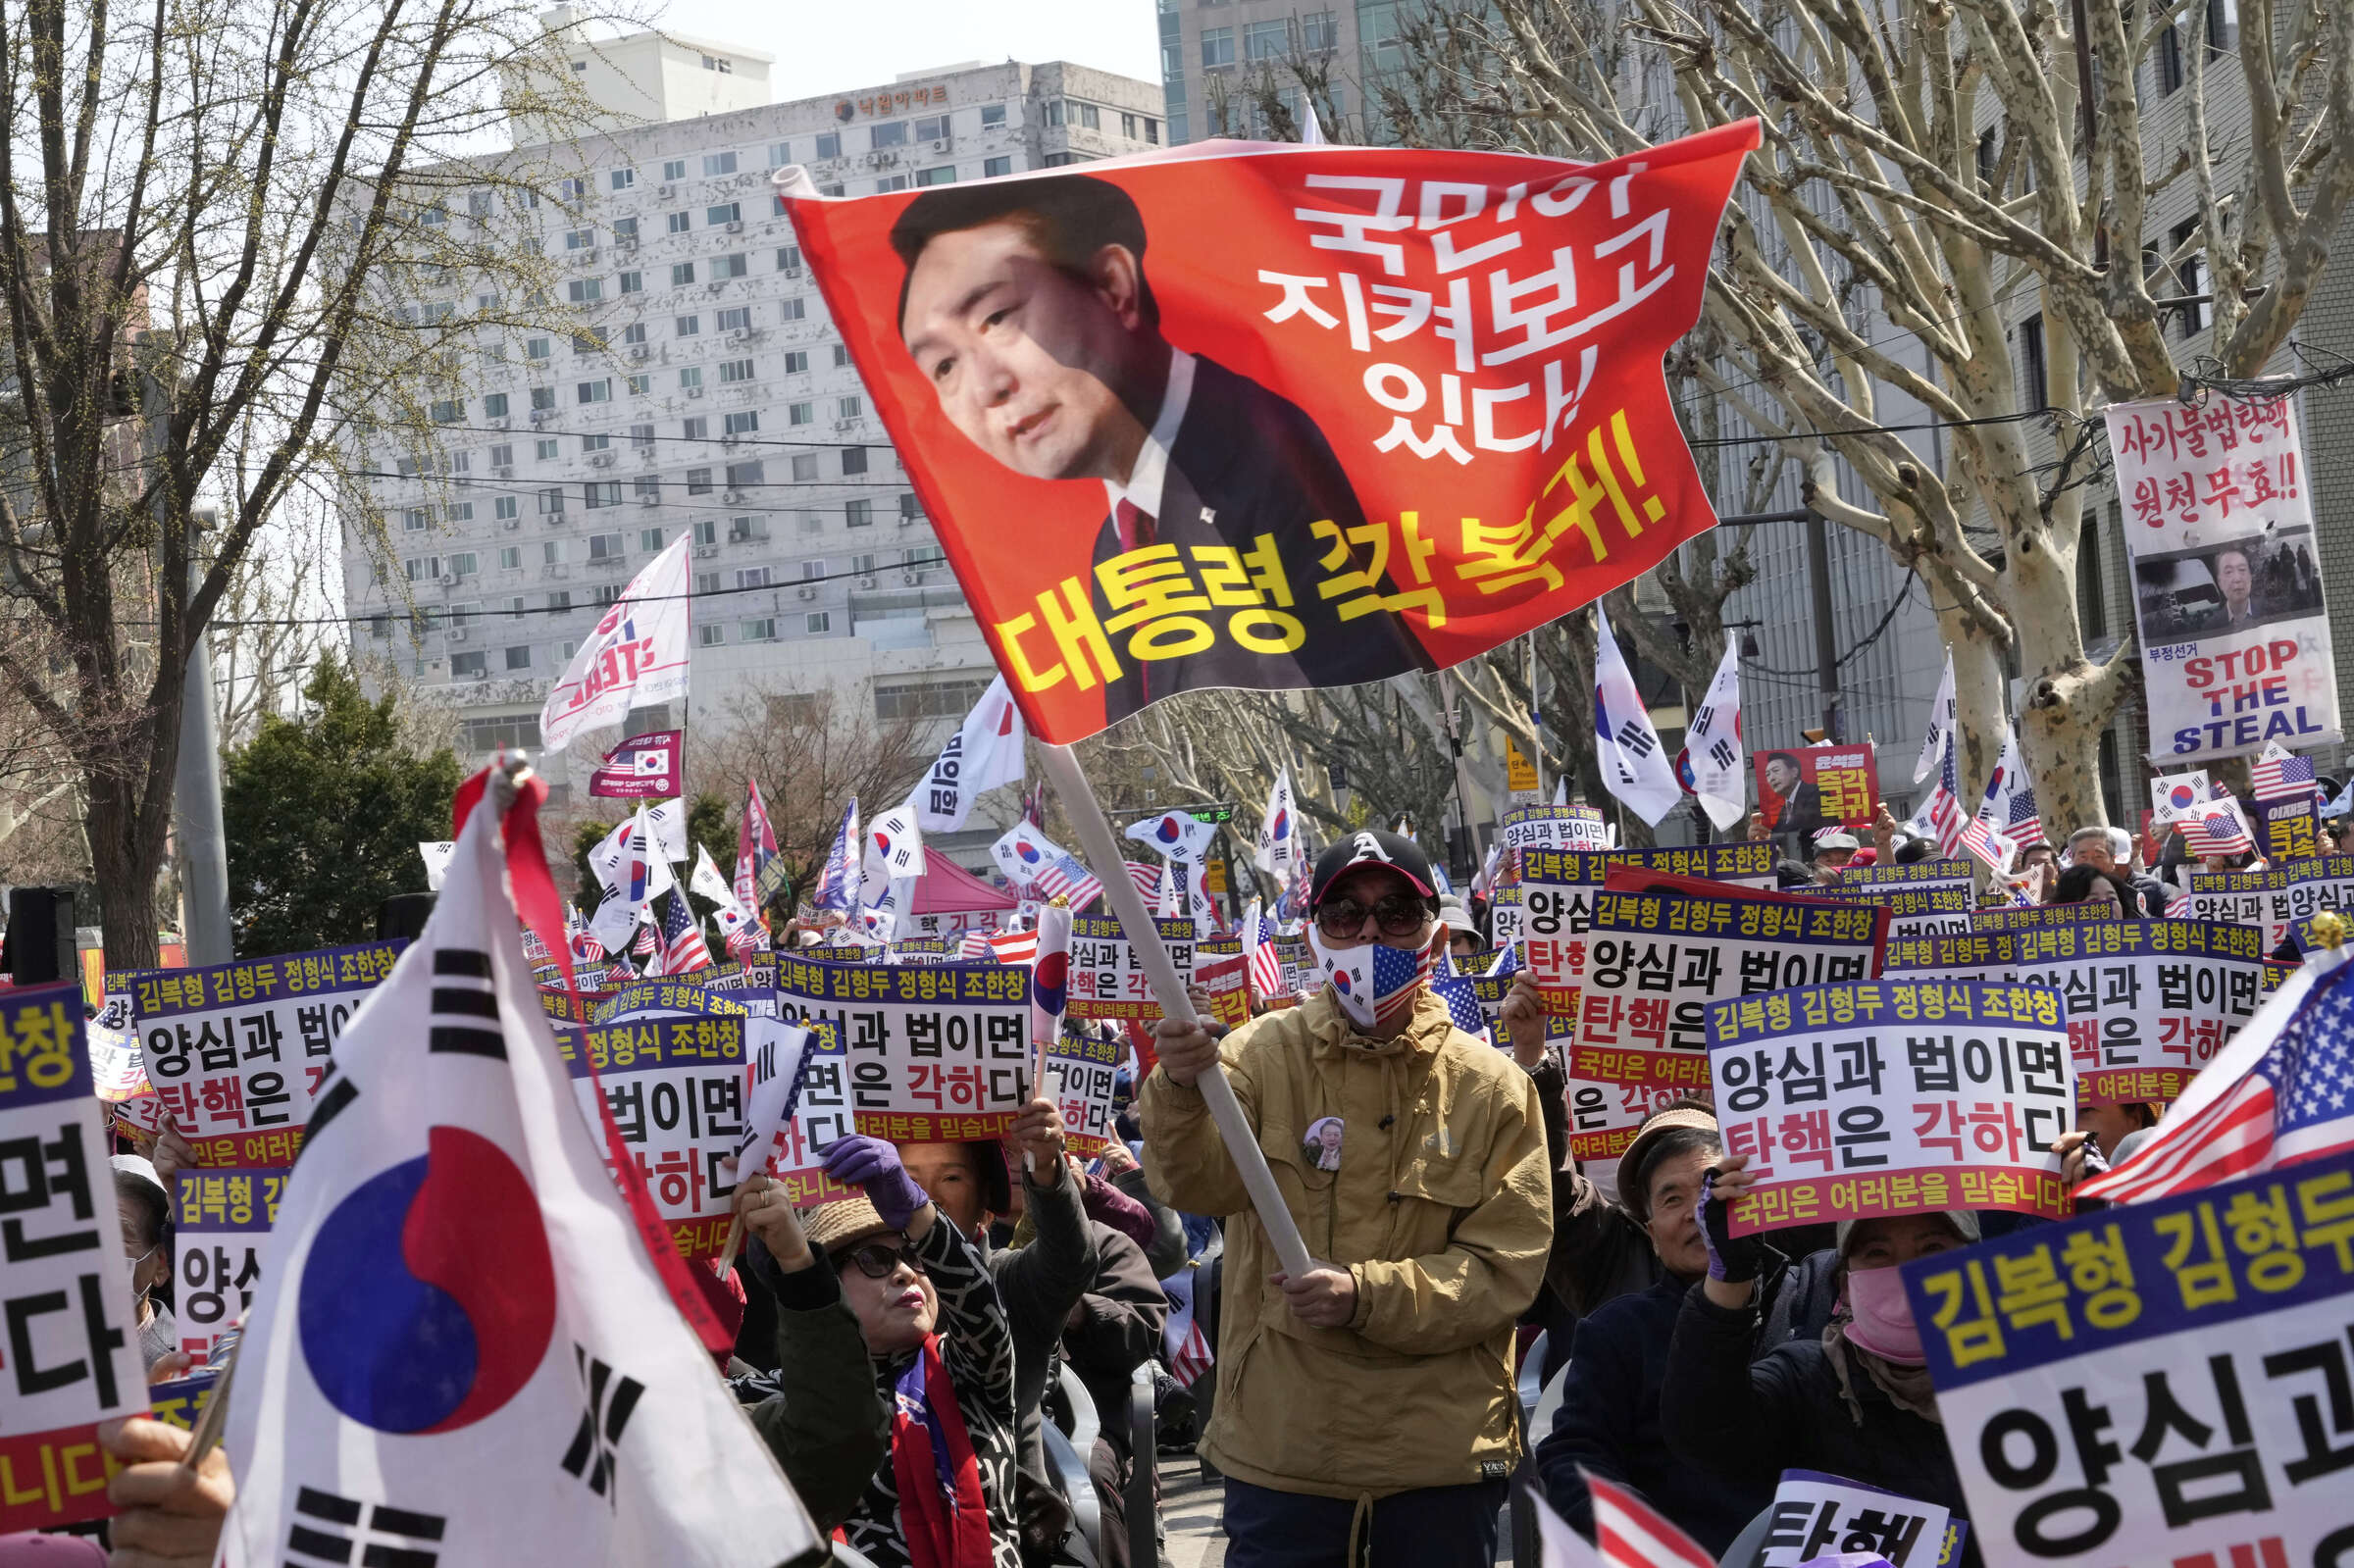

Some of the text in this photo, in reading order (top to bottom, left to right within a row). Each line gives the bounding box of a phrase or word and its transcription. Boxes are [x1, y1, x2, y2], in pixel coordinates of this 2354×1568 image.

[858, 84, 947, 116] 낙원아파트
[1257, 208, 1674, 373] 지켜보고
[1362, 344, 1599, 466] 있다!
[994, 532, 1306, 693] 대통령
[1456, 408, 1666, 595] 복귀!
[2148, 642, 2198, 663] 부정선거
[2183, 639, 2299, 688] STOP
[2202, 675, 2290, 717] THE
[2173, 705, 2324, 754] STEAL
[1507, 822, 1604, 847] 양심과 법이면
[2269, 816, 2314, 837] 즉각
[1347, 832, 1394, 867] A
[1525, 852, 1580, 882] 김복형
[1714, 843, 1772, 874] 조한창
[2270, 835, 2316, 862] 구속
[1843, 861, 1971, 884] 김복형 김형두 정형식 조한창
[2193, 872, 2265, 891] 김복형 김형두
[2287, 859, 2324, 882] 김복형
[1597, 894, 1873, 941] 김복형 김형두 정형식 조한창
[1891, 892, 1929, 915] 정형식
[1931, 890, 1964, 911] 조한창
[1972, 902, 2111, 931] 김복형 김형두 정형식 조한창
[2195, 896, 2264, 922] 양심과
[1091, 920, 1120, 936] 김형두
[1160, 922, 1194, 940] 조한창
[2021, 927, 2075, 960] 김복형
[2082, 924, 2143, 953] 김형두
[2149, 922, 2206, 952] 정형식
[2212, 927, 2261, 958] 조한창
[836, 947, 862, 960] 조한창
[1592, 939, 1722, 995] 양심과
[1886, 936, 1990, 967] 김복형 김형두
[137, 945, 396, 1013] 김복형 김형두 정형식 조한창
[619, 986, 655, 1011] 김형두
[660, 984, 705, 1011] 정형식
[778, 959, 825, 996] 김복형
[832, 969, 892, 999] 김형두
[897, 970, 957, 1000] 정형식
[964, 970, 1026, 1001] 조한창
[2157, 963, 2261, 1016] 법이면
[1093, 1003, 1138, 1019] 여러분을
[1582, 994, 1708, 1051] 탄핵은
[1714, 985, 2059, 1041] 김복형 김형두 정형식 조한창
[147, 1010, 283, 1078] 양심과
[585, 1019, 742, 1069] 정형식 조한창
[905, 1012, 1025, 1059] 법이면
[1085, 1040, 1117, 1063] 조한창
[1577, 1050, 1648, 1081] 국민은
[1720, 1036, 2067, 1112] 양심과 법이면
[2097, 1071, 2179, 1100] 여러분을
[156, 1072, 291, 1134] 탄핵은
[907, 1064, 1030, 1111] 각하다
[602, 1075, 743, 1143] 법이면
[853, 1112, 932, 1140] 여러분을
[1725, 1100, 2067, 1181] 탄핵은 각하다
[179, 1175, 253, 1225] 김복형
[1733, 1170, 2073, 1227] 국민은 여러분을 믿습니다!
[1923, 1170, 2354, 1369] 김복형 김형두
